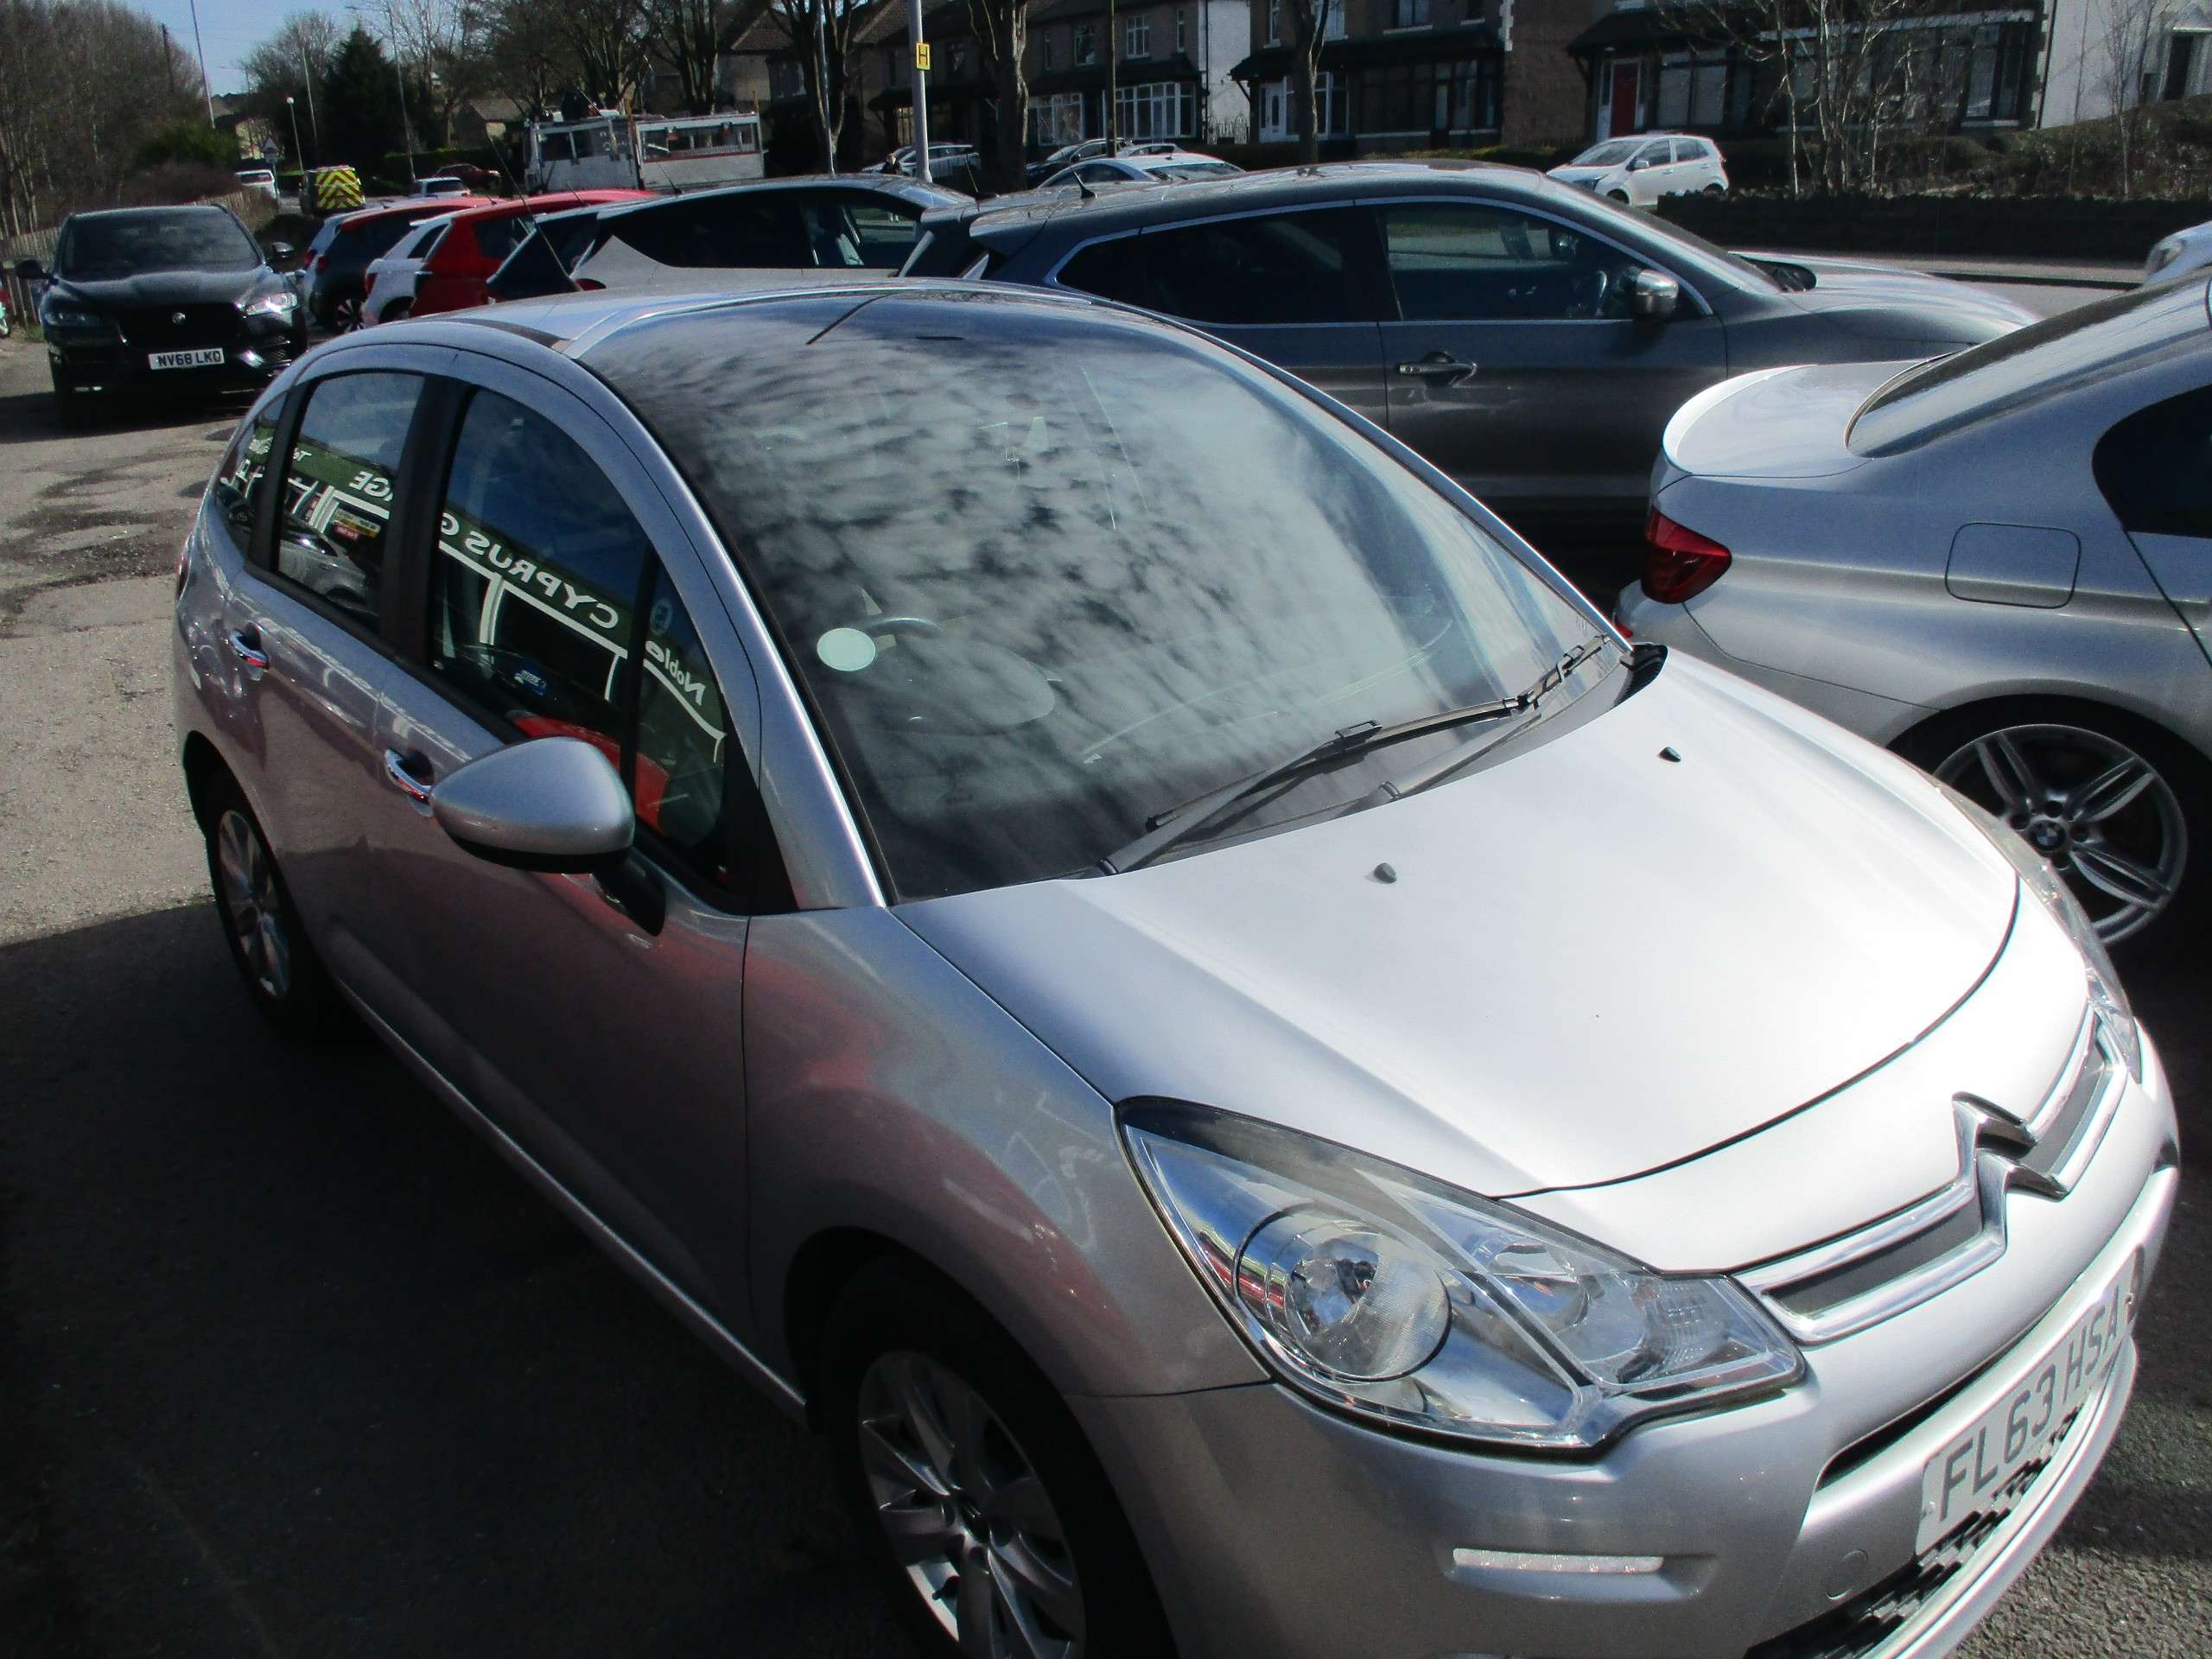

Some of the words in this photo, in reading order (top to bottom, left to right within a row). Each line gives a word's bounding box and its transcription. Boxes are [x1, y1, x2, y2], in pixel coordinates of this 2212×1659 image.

[918, 45, 927, 66] H
[157, 353, 193, 367] NV68
[1939, 1364, 2056, 1522] FL63
